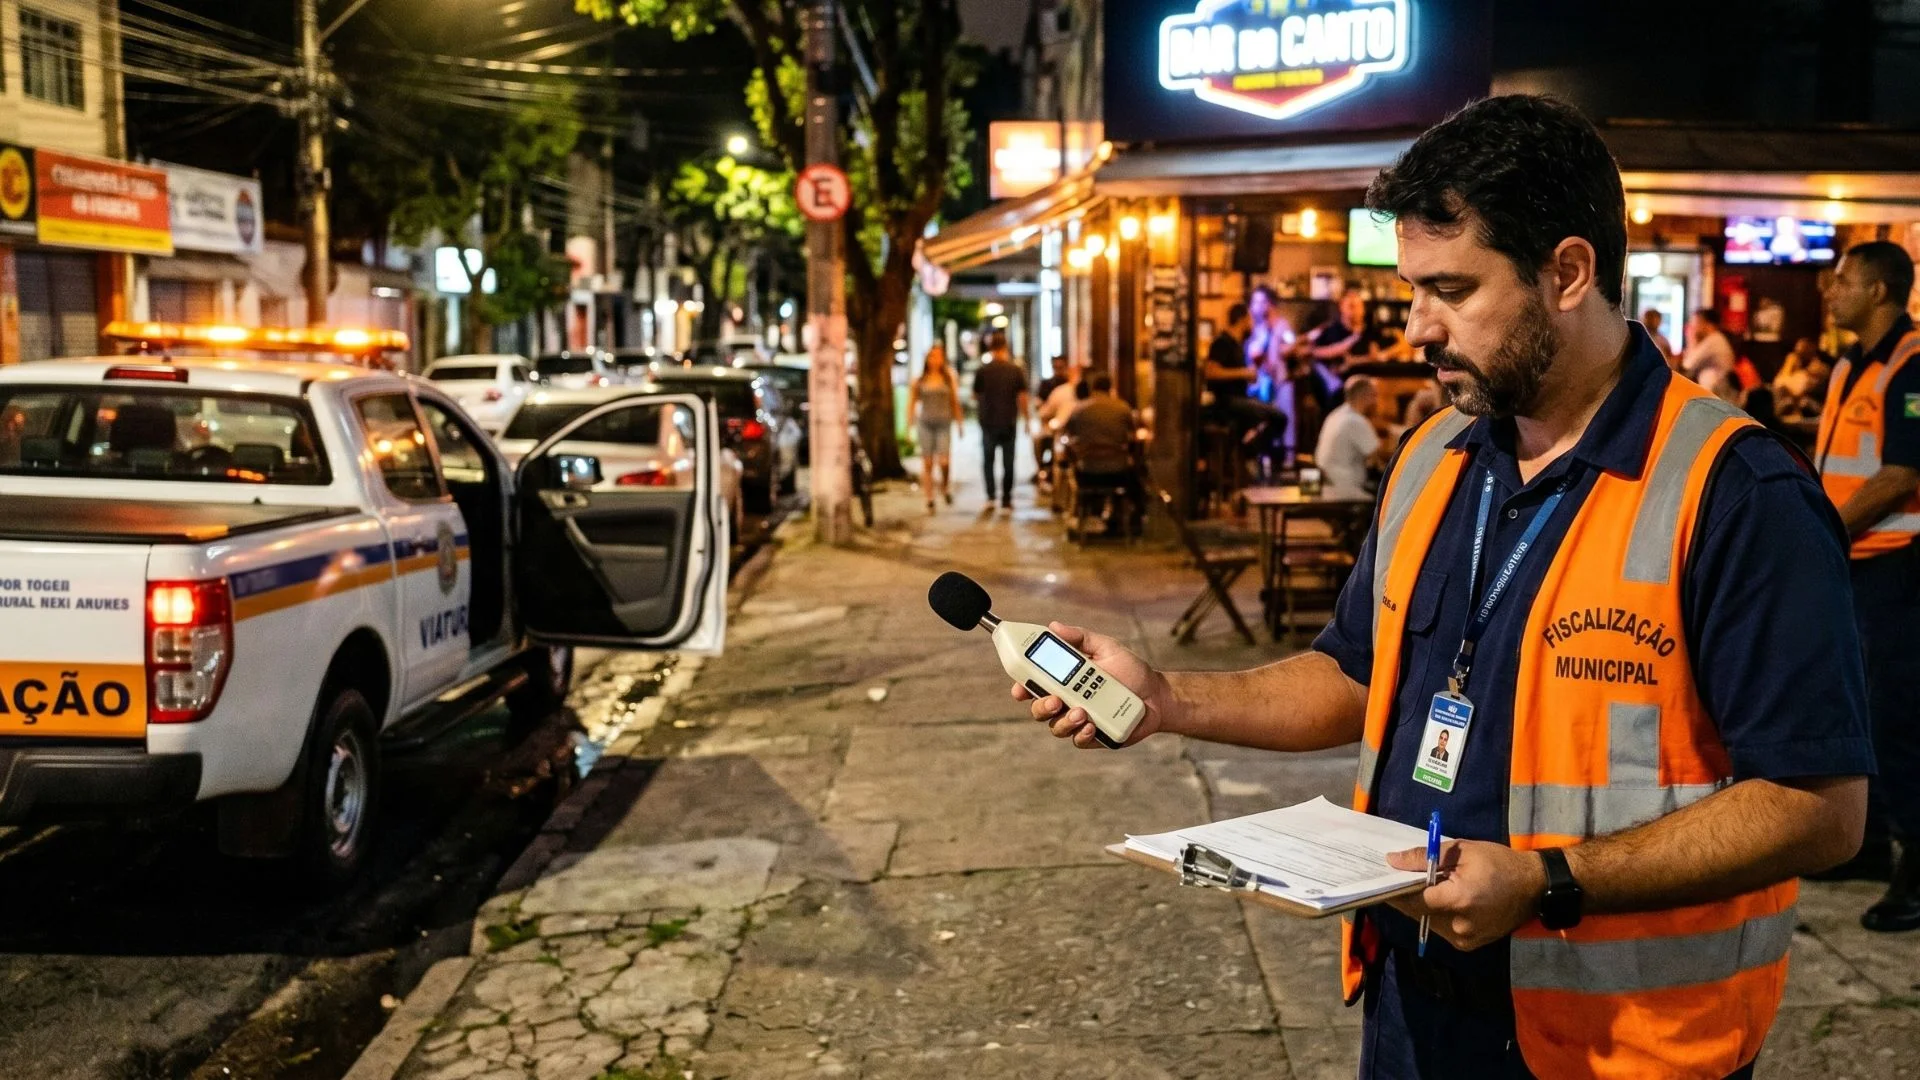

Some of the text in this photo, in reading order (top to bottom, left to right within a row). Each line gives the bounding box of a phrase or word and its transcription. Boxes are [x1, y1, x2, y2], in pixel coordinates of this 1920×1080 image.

[1169, 24, 1235, 77] BAR
[1281, 7, 1394, 67] CANTO
[812, 178, 833, 207] E
[1542, 607, 1676, 657] FISCALIZAÇÃO
[1555, 656, 1658, 685] MUNICIPAL
[0, 671, 130, 725] ÇÃO
